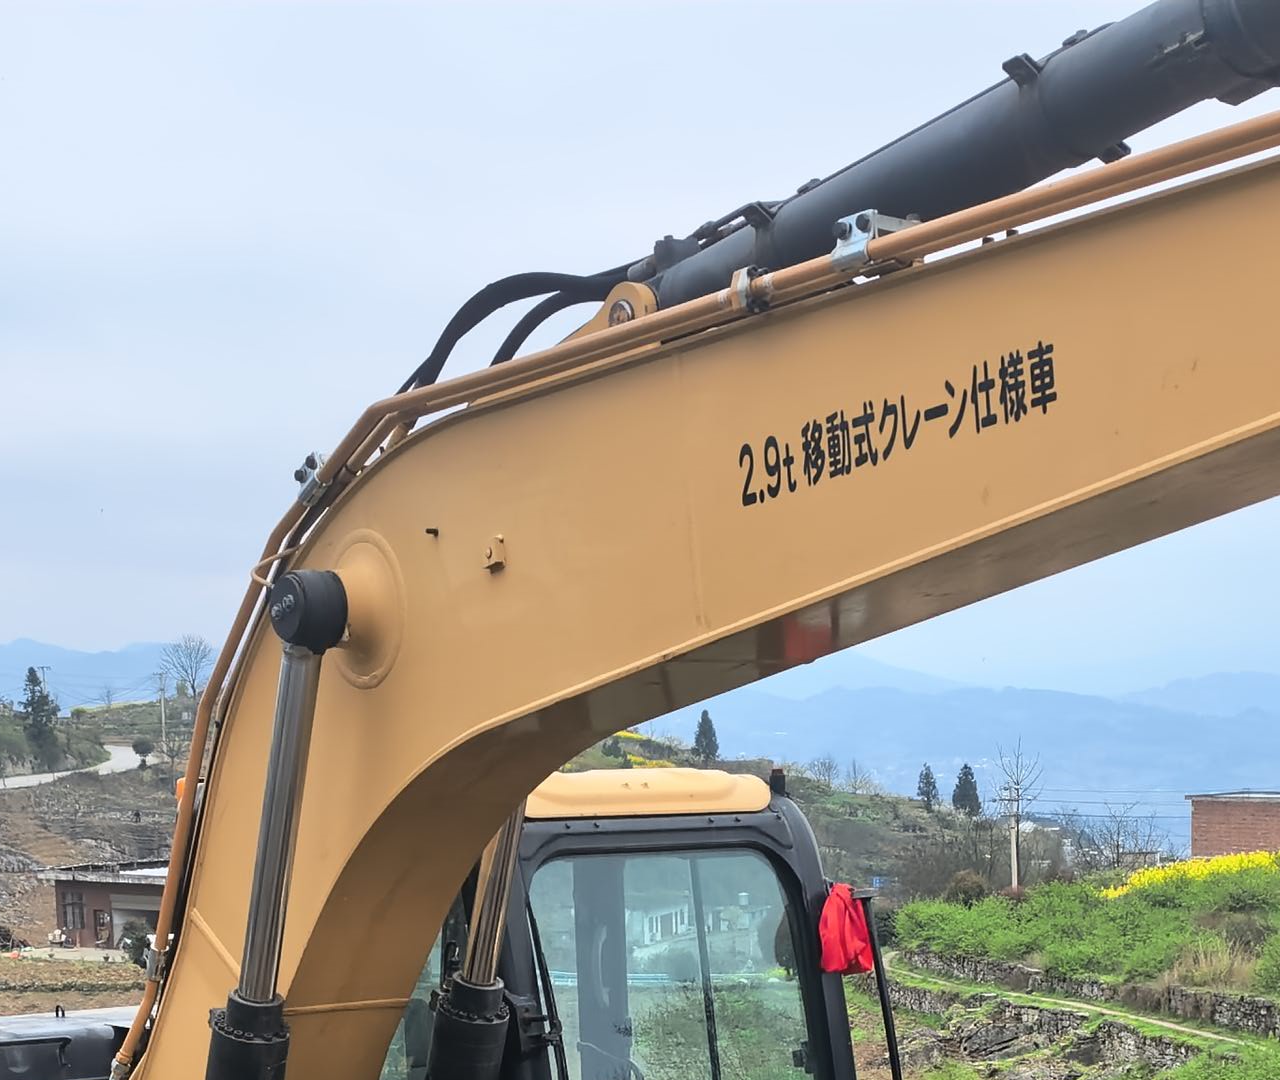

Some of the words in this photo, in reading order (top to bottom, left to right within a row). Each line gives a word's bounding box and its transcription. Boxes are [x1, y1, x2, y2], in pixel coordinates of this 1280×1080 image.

[738, 435, 797, 507] 2.9t
[801, 340, 1058, 487] 移動式クレーン仕様車
